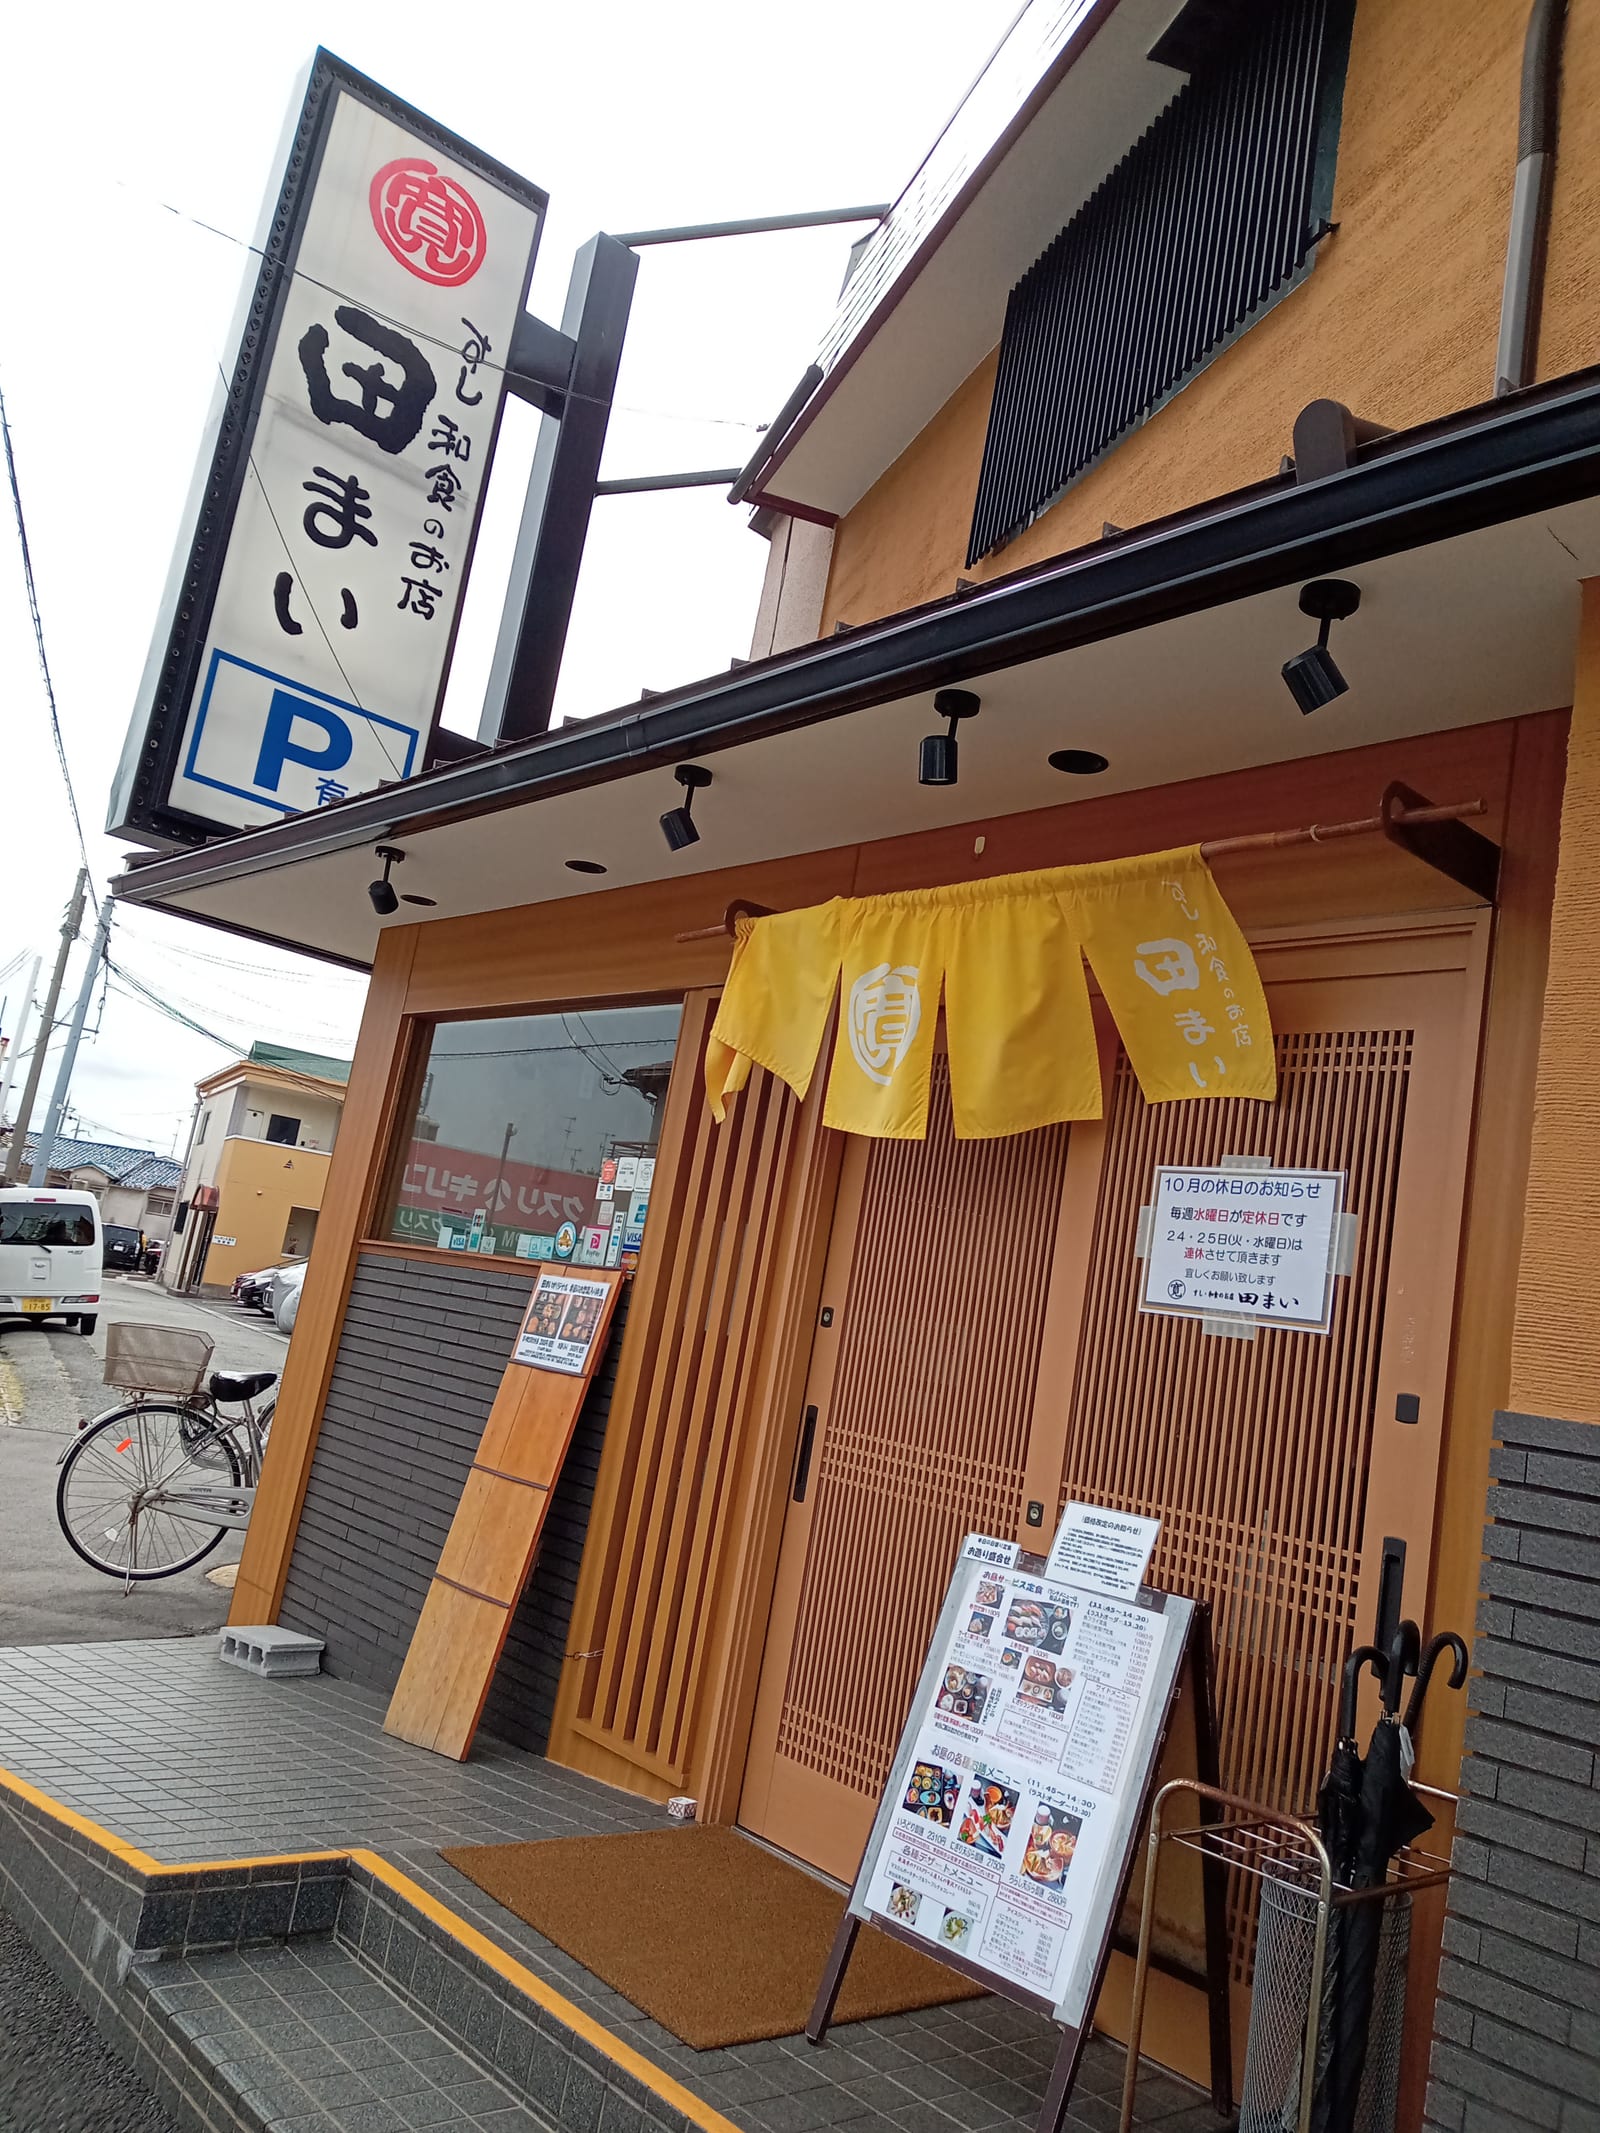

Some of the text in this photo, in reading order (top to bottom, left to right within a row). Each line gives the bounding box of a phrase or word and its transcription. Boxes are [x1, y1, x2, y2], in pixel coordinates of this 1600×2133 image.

[253, 687, 353, 792] P
[1164, 1176, 1321, 1199] 10月の休日のお知らせ
[1170, 1206, 1307, 1228] 毎週水曜日が定休日です
[1183, 1247, 1282, 1266] 連休させて頂きます
[1185, 1268, 1276, 1286] 宜しくお願い致します
[1237, 1289, 1300, 1312] 田まい
